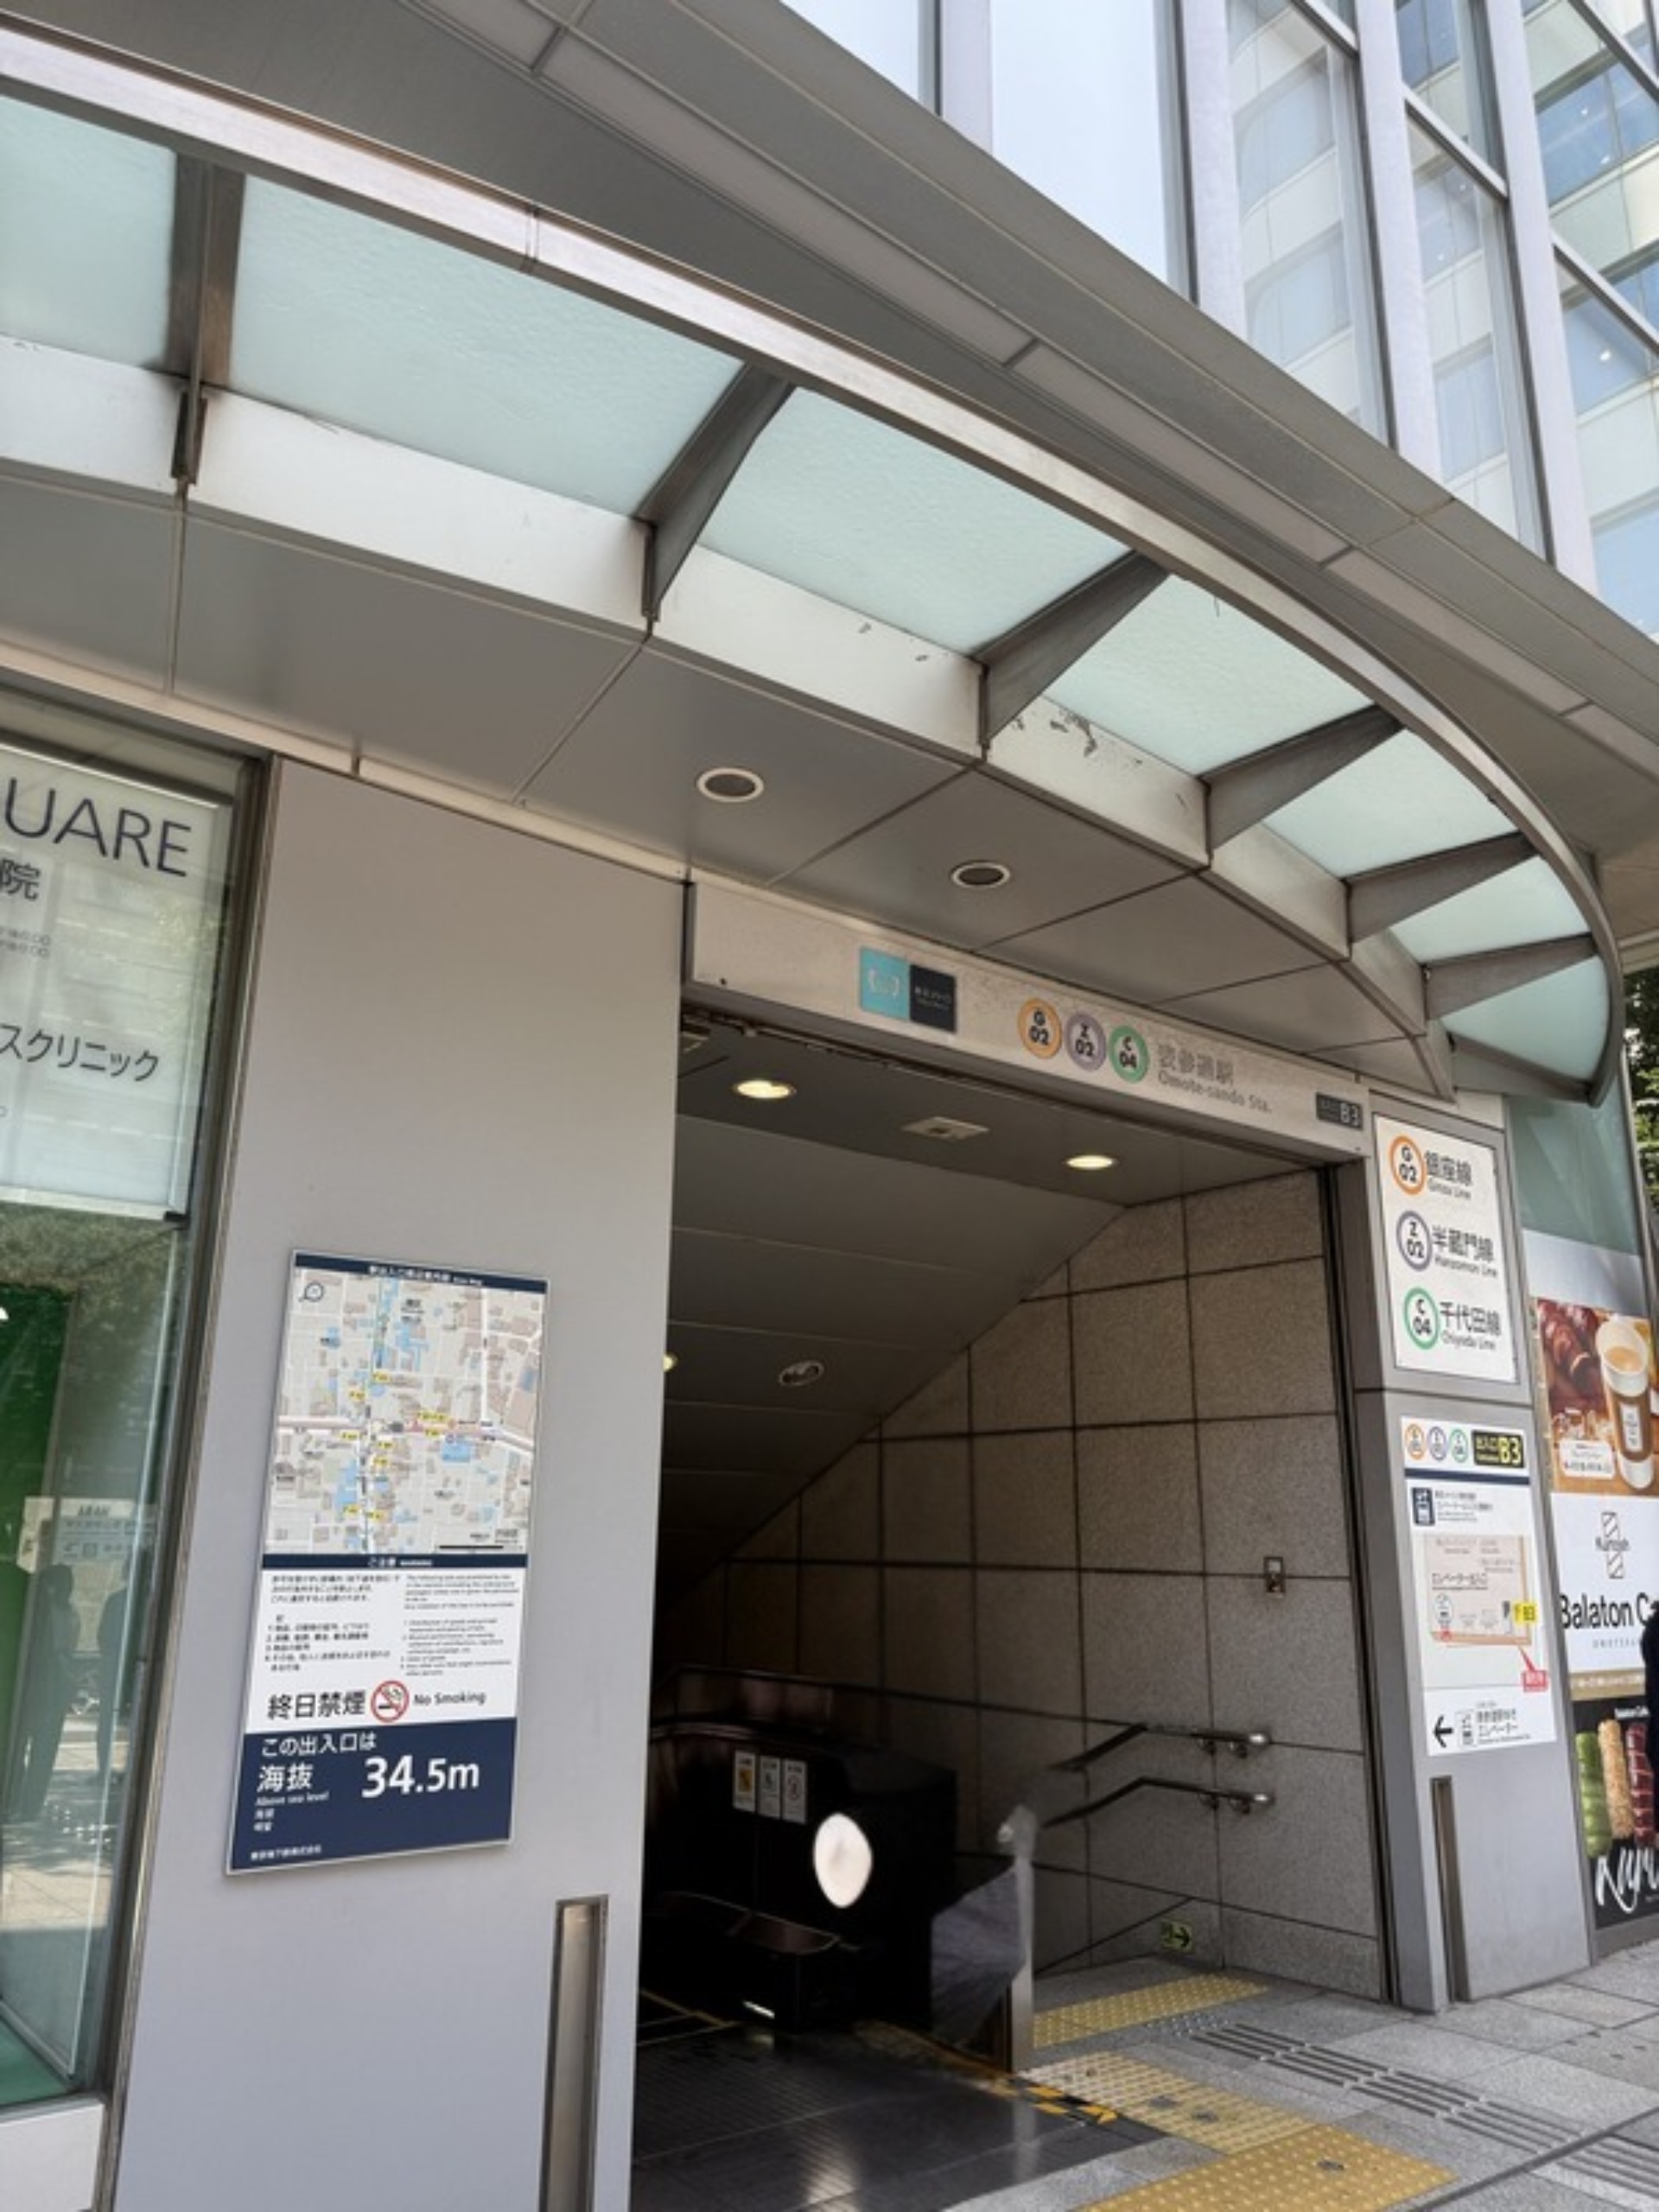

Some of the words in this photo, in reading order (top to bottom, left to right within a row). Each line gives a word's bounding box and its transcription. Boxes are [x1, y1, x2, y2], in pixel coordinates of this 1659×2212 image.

[4, 779, 192, 877] UARE
[0, 1023, 159, 1081] スクリニック
[1440, 1301, 1502, 1337] 千代田線
[1498, 1437, 1522, 1465] B3
[1560, 1592, 1635, 1630] Balaton
[267, 1689, 366, 1719] 終日禁煙
[414, 1694, 430, 1706] No
[434, 1691, 486, 1707] Smoking
[262, 1732, 378, 1758] この出入口は
[257, 1763, 314, 1793] 海抜
[361, 1755, 480, 1800] 34.5m
